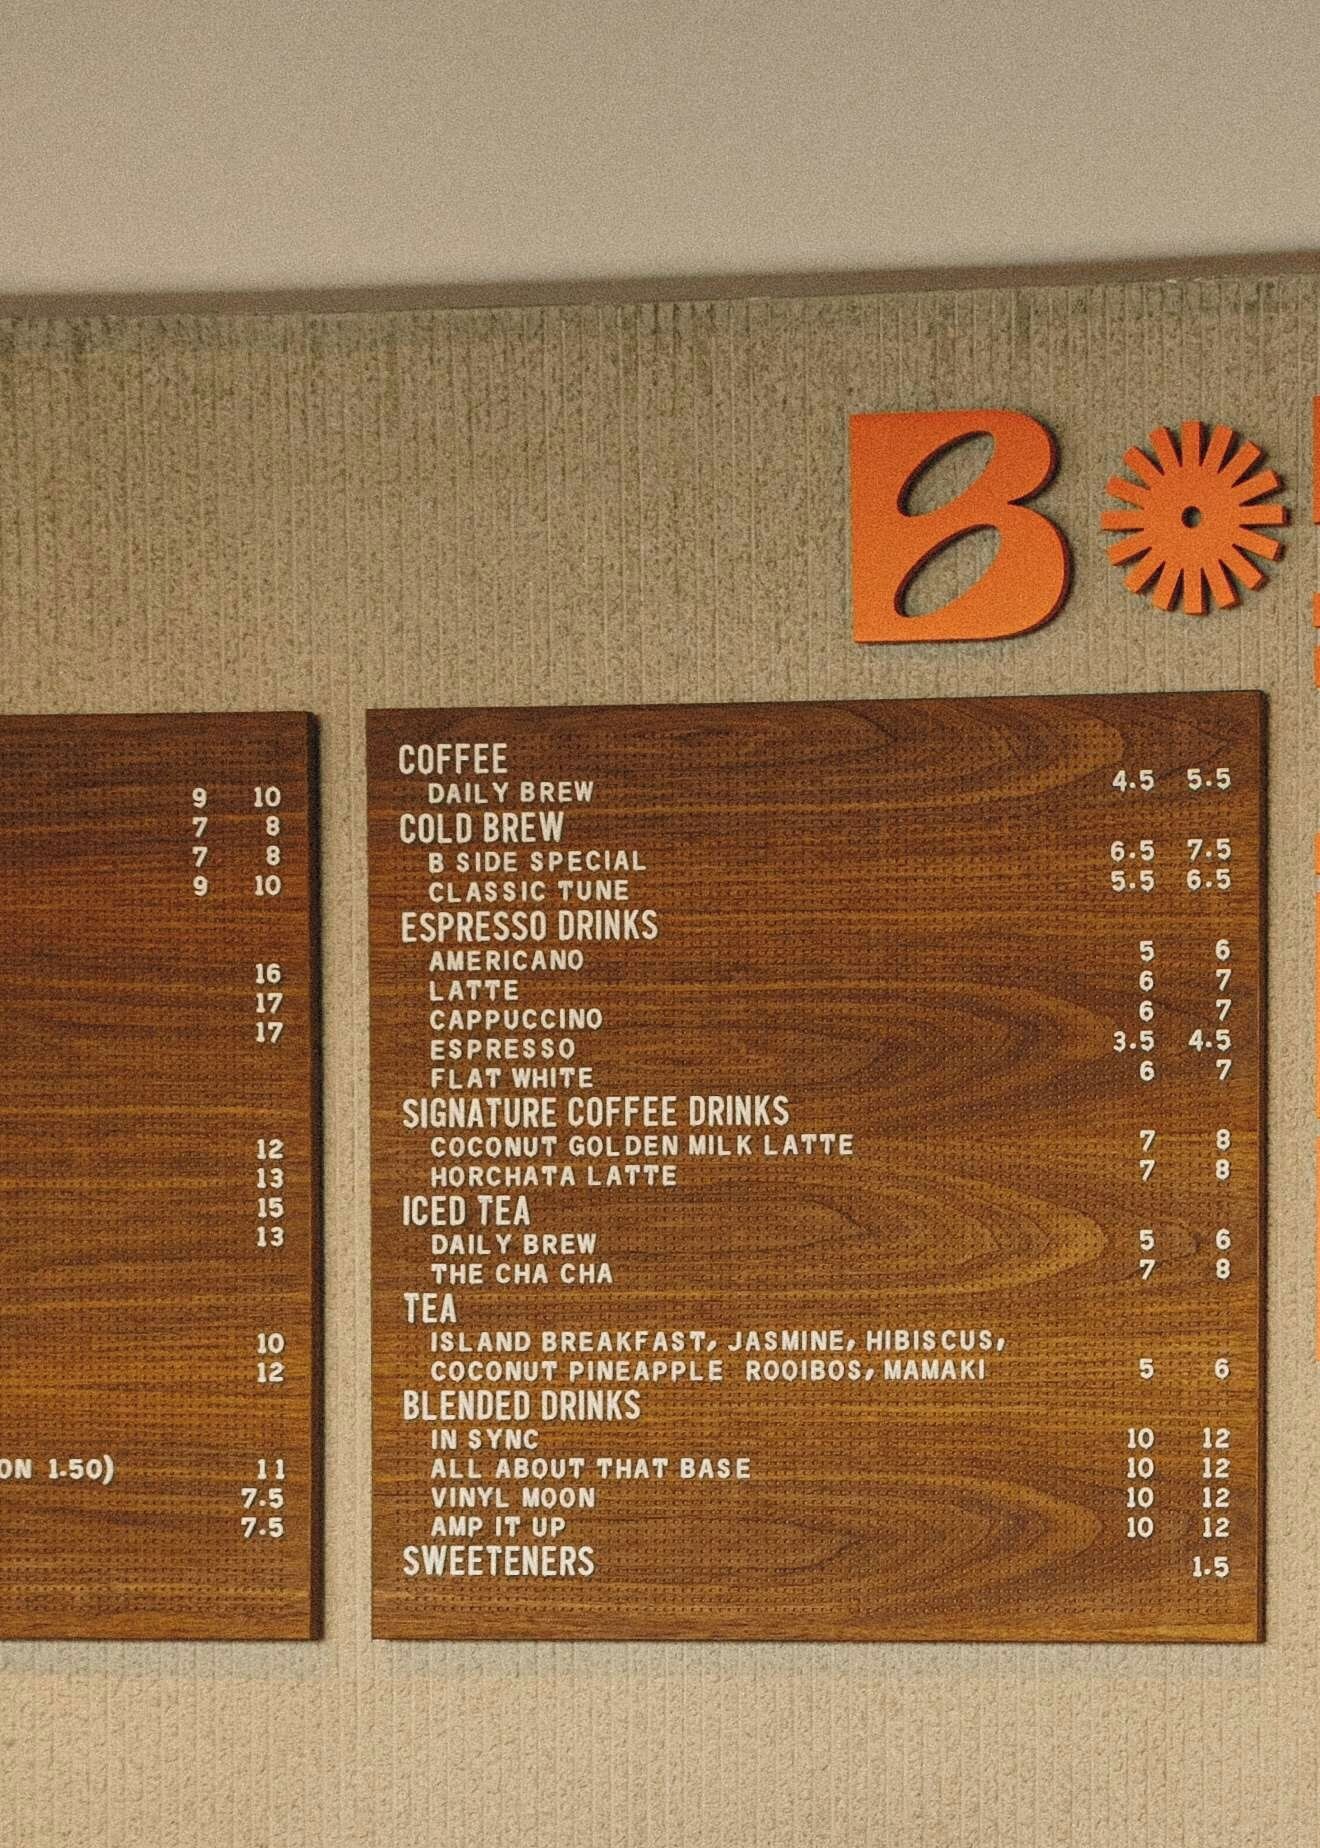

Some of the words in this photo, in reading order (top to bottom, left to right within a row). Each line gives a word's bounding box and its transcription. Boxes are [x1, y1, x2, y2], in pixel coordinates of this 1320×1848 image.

[849, 411, 1070, 643] B
[399, 743, 509, 776] COFFEE
[1113, 770, 1156, 794] 4.5
[1187, 768, 1233, 792] 5.5
[192, 788, 208, 810] 9
[254, 786, 282, 809] 10
[429, 782, 510, 806] DAILY
[521, 781, 595, 805] BREW
[193, 817, 210, 839] 7
[266, 816, 281, 838] 8
[400, 813, 473, 845] COLD
[484, 811, 566, 845] BREW
[193, 847, 209, 869] 7
[266, 846, 282, 867] 8
[429, 853, 446, 875] B
[457, 852, 519, 874] SIDE
[531, 850, 648, 874] SPECIAL
[1111, 840, 1156, 864] 6.5
[1187, 839, 1233, 862] 7.5
[194, 876, 210, 898] 9
[255, 875, 283, 898] 10
[429, 881, 547, 905] CLASSIC
[558, 880, 630, 903] TUNE
[1111, 870, 1156, 894] 5.5
[1187, 869, 1233, 892] 6.5
[402, 911, 548, 945] ESPRESSO
[559, 910, 659, 943] DRINKS
[429, 950, 585, 974] AMERICANO
[1140, 941, 1156, 964] 5
[1216, 939, 1232, 963] 6
[256, 964, 282, 986] 16
[1140, 971, 1155, 993] 6
[1216, 969, 1233, 993] 7
[430, 980, 520, 1003] LATTE
[256, 993, 284, 1015] 17
[1140, 1000, 1155, 1024] 6
[1216, 999, 1233, 1023] 7
[430, 1008, 604, 1033] CAPPUCCINO
[256, 1022, 285, 1045] 17
[1114, 1030, 1156, 1054] 3.5
[1189, 1029, 1233, 1053] 4.5
[431, 1038, 576, 1062] ESPRESSO
[432, 1068, 503, 1091] FLAT
[512, 1067, 595, 1090] WHITE
[1140, 1061, 1156, 1083] 6
[1216, 1059, 1233, 1082] 7
[403, 1097, 558, 1131] SIGNATURE
[568, 1096, 678, 1129] COFFEE
[690, 1095, 791, 1128] DRINKS
[257, 1139, 285, 1161] 12
[431, 1136, 559, 1160] COCONUT
[569, 1135, 680, 1159] GOLDEN
[689, 1135, 754, 1158] MILK
[764, 1134, 855, 1157] LATTE
[1140, 1130, 1157, 1153] 7
[1217, 1129, 1232, 1152] 8
[257, 1168, 285, 1190] 13
[431, 1166, 577, 1189] HORCHATA
[588, 1165, 678, 1188] LATTE
[1140, 1160, 1157, 1183] 7
[1216, 1159, 1231, 1182] 8
[258, 1197, 286, 1220] 15
[403, 1196, 467, 1228] ICED
[477, 1195, 532, 1227] TEA
[257, 1226, 286, 1249] 13
[432, 1234, 513, 1257] DAILY
[524, 1233, 598, 1257] BREW
[1140, 1230, 1156, 1253] 5
[1216, 1228, 1233, 1251] 6
[431, 1264, 485, 1287] THE
[496, 1263, 550, 1286] CHA
[560, 1263, 614, 1286] CHA
[1140, 1259, 1157, 1282] 7
[1216, 1258, 1232, 1281] 8
[404, 1292, 458, 1325] TEA
[258, 1333, 286, 1356] 10
[431, 1332, 533, 1354] ISLAND
[542, 1331, 718, 1354] BREAKFAST,
[728, 1330, 857, 1353] JASMINE,
[867, 1330, 1007, 1353] HIBISCUS,
[258, 1362, 286, 1385] 12
[431, 1361, 559, 1384] COCONUT
[570, 1360, 724, 1384] PINEAPPLE
[746, 1360, 876, 1383] ROOIBOS,
[884, 1360, 986, 1383] MAMAKI
[1140, 1359, 1156, 1381] 5
[1215, 1358, 1231, 1381] 6
[404, 1390, 531, 1423] BLENDED
[542, 1389, 642, 1423] DRINKS
[432, 1429, 458, 1452] IN
[469, 1429, 540, 1452] SYNC
[1128, 1428, 1156, 1451] 10
[1203, 1428, 1232, 1451] 12
[49, 1455, 116, 1487] 1.50)
[431, 1458, 483, 1480] ALL
[496, 1458, 587, 1481] ABOUT
[597, 1458, 670, 1481] THAT
[680, 1458, 752, 1481] BASE
[1127, 1457, 1156, 1481] 10
[1203, 1457, 1232, 1480] 12
[241, 1488, 285, 1511] 7.5
[432, 1487, 511, 1510] VINYL
[522, 1487, 596, 1511] MOON
[1127, 1487, 1155, 1511] 10
[1203, 1487, 1232, 1510] 12
[241, 1517, 286, 1540] 7.5
[431, 1516, 485, 1540] AMP
[496, 1516, 522, 1539] IT
[533, 1517, 567, 1539] UP
[1128, 1517, 1155, 1540] 10
[1203, 1517, 1232, 1540] 12
[403, 1545, 596, 1578] SWEETENERS
[1193, 1556, 1231, 1580] 1.5
